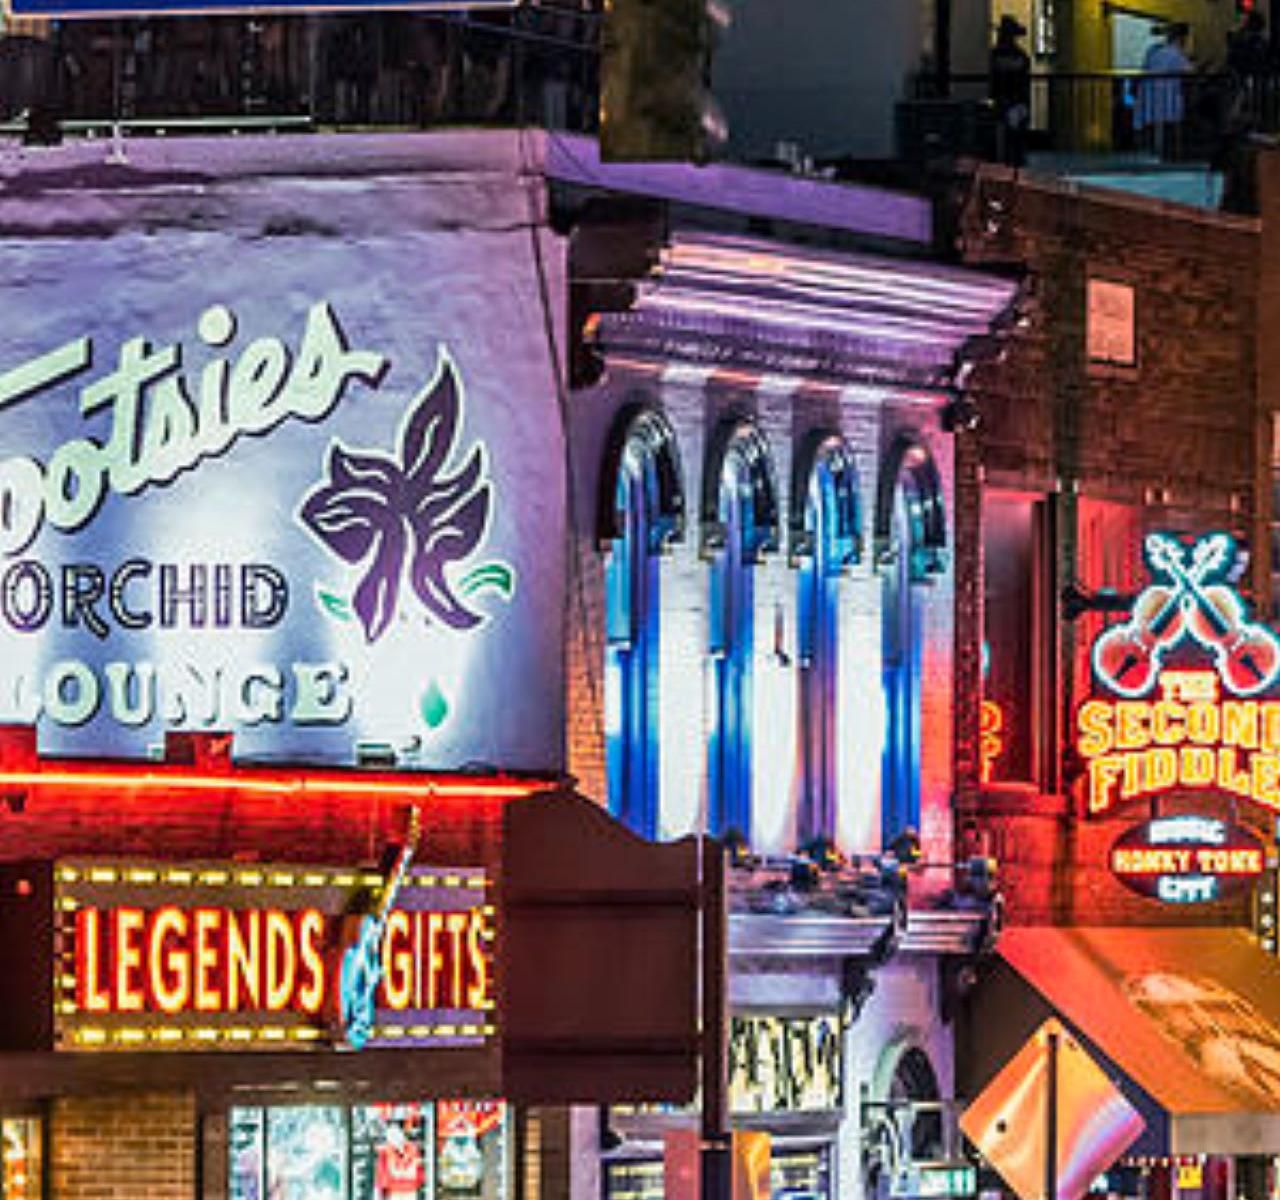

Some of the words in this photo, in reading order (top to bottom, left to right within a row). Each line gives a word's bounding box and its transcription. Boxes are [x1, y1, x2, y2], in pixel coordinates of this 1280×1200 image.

[0, 300, 392, 558] ootsies
[0, 558, 290, 638] ORCHID
[82, 905, 325, 1012] LEGENDS
[382, 907, 488, 1010] GIFTS
